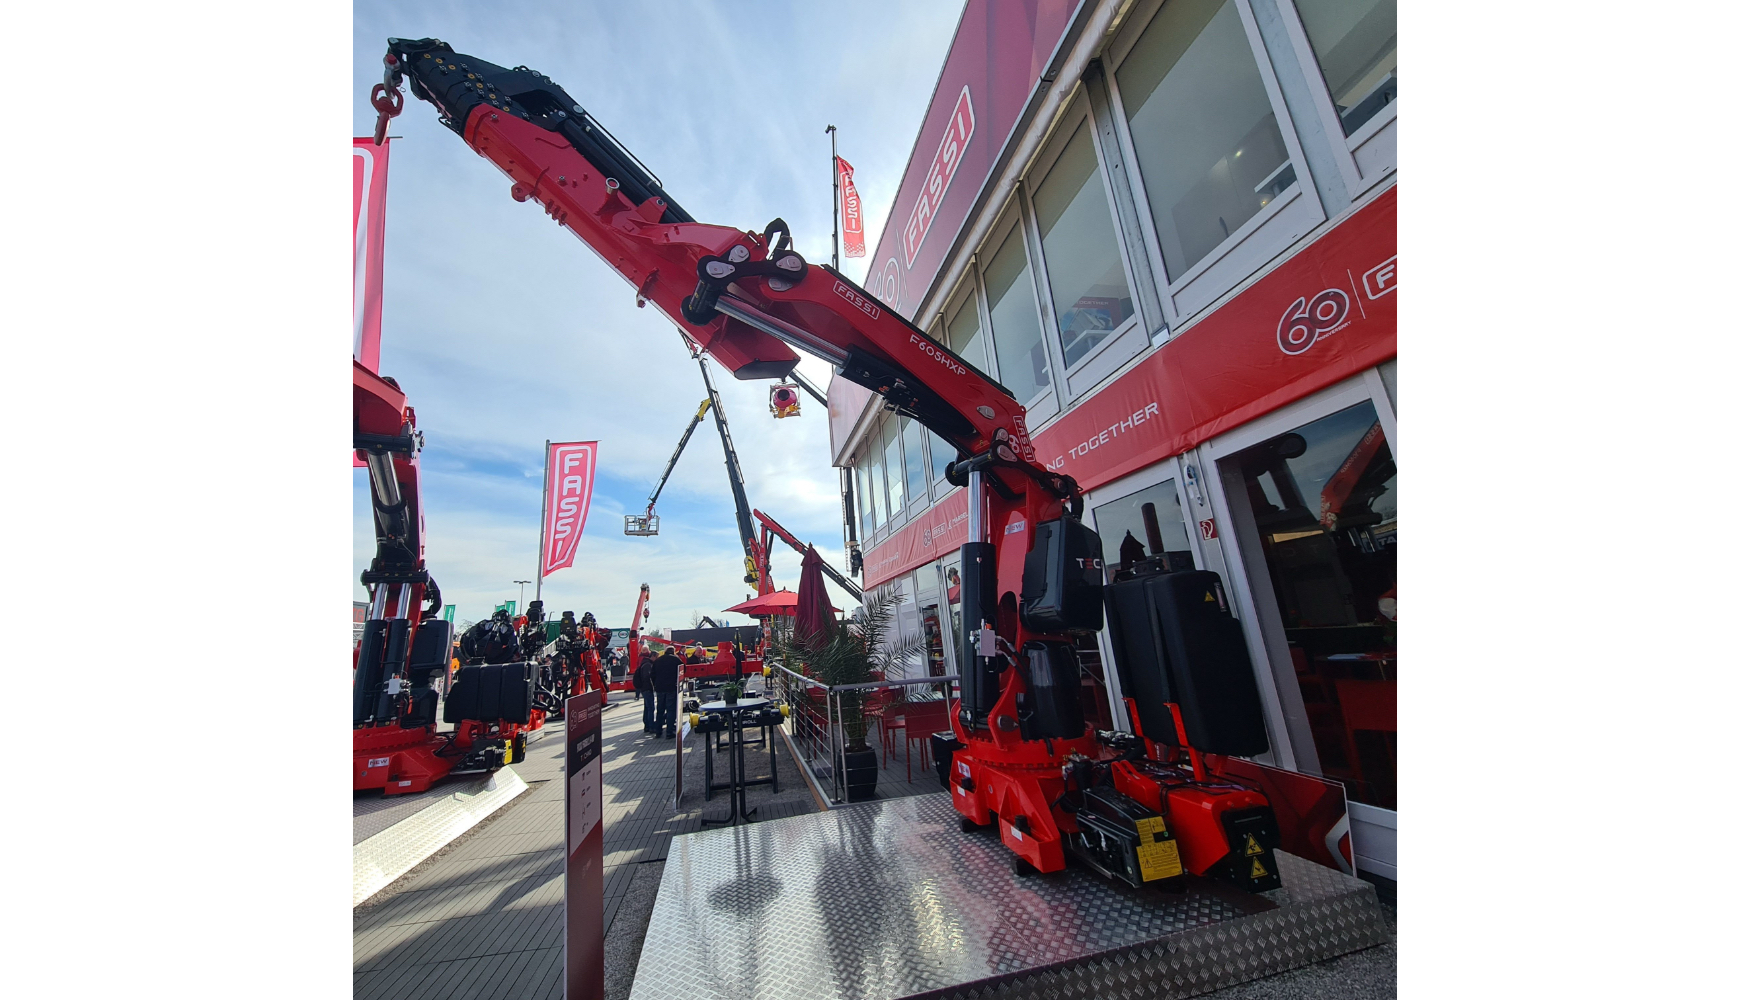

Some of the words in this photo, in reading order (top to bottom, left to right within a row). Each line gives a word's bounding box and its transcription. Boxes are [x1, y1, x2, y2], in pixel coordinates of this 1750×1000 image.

[909, 112, 966, 253] FASSI
[838, 284, 876, 316] FASSI
[1277, 288, 1350, 355] 60
[909, 334, 967, 376] F605HXP
[1016, 419, 1033, 459] FASSI
[1068, 402, 1160, 460] TOGETHER
[554, 453, 583, 560] FASSI
